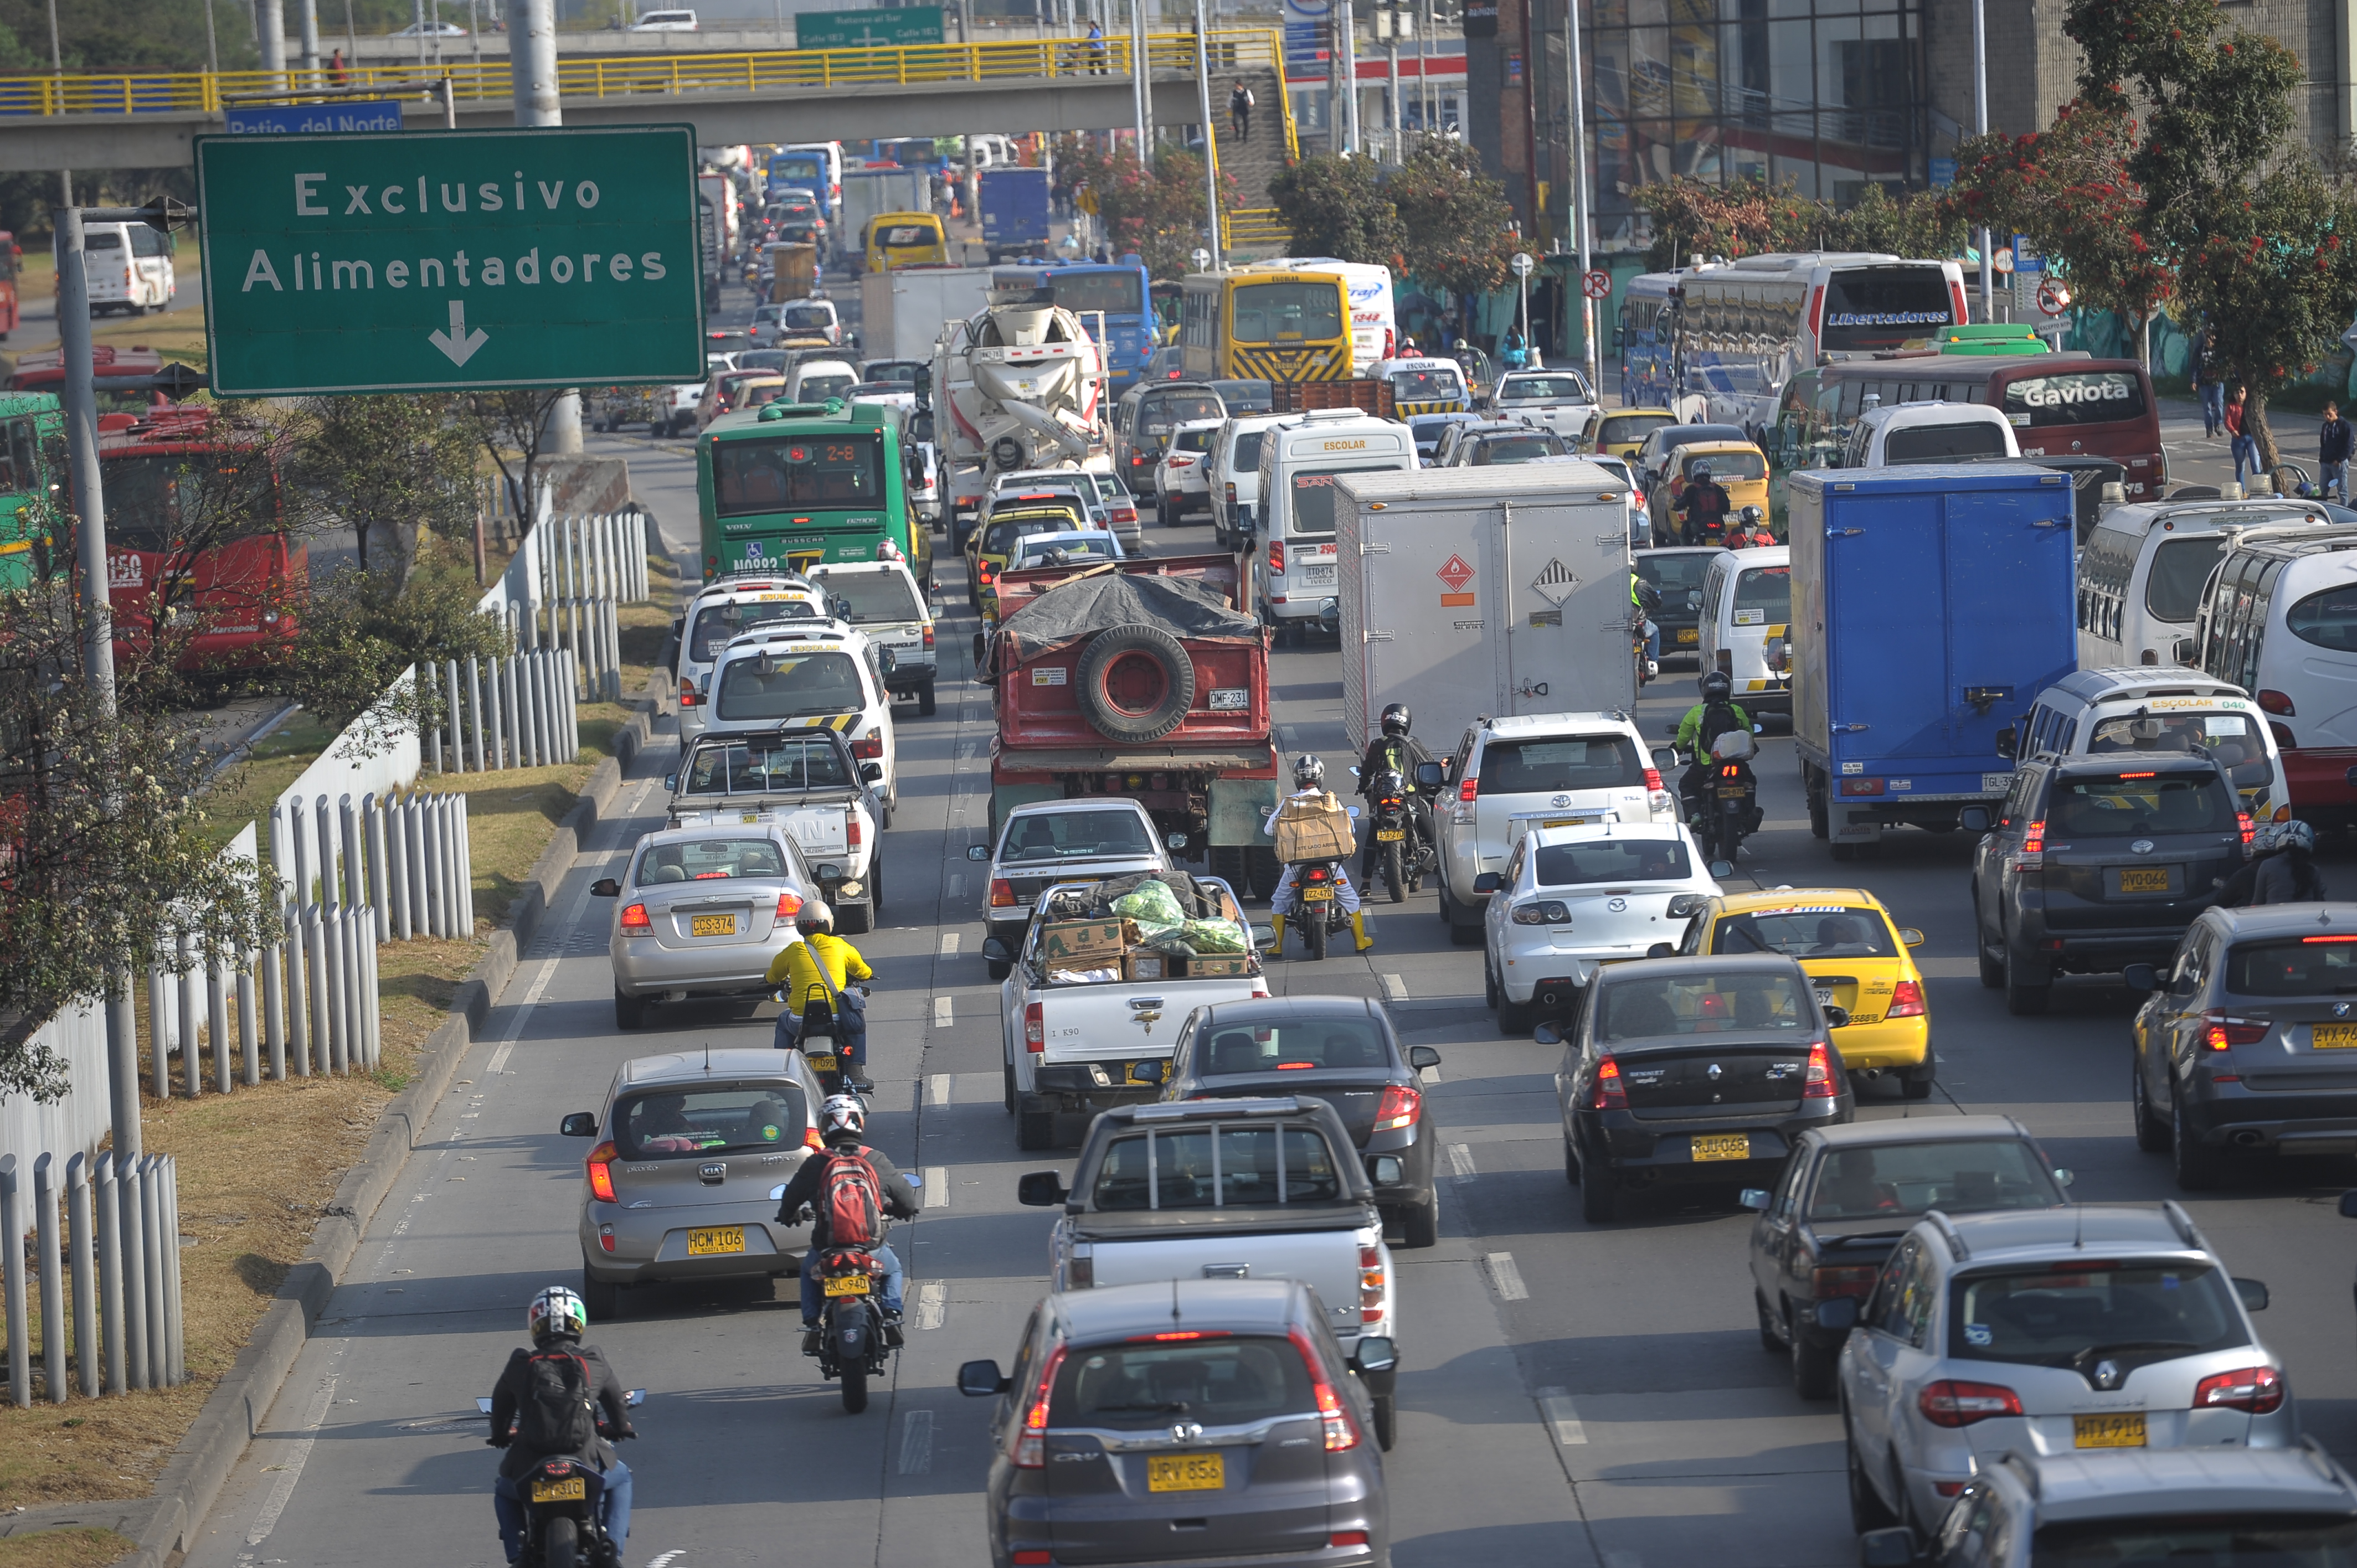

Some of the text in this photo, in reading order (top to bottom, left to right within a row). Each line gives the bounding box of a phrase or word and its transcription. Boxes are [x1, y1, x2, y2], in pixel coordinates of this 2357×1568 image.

[886, 14, 902, 23] Sur
[303, 117, 333, 133] del
[339, 115, 398, 132] Norte
[295, 171, 600, 216] Exclusivo
[242, 247, 667, 292] Alimentadores
[1828, 311, 1948, 326] Libertadores
[2024, 380, 2129, 407] Gaviota
[1324, 441, 1366, 451] ESCOLAR
[827, 445, 855, 461] 2-8
[2153, 699, 2246, 710] ESCOLAR 040
[1063, 1028, 1079, 1036] K90
[627, 1164, 659, 1173] picanto
[704, 1167, 723, 1175] KIA
